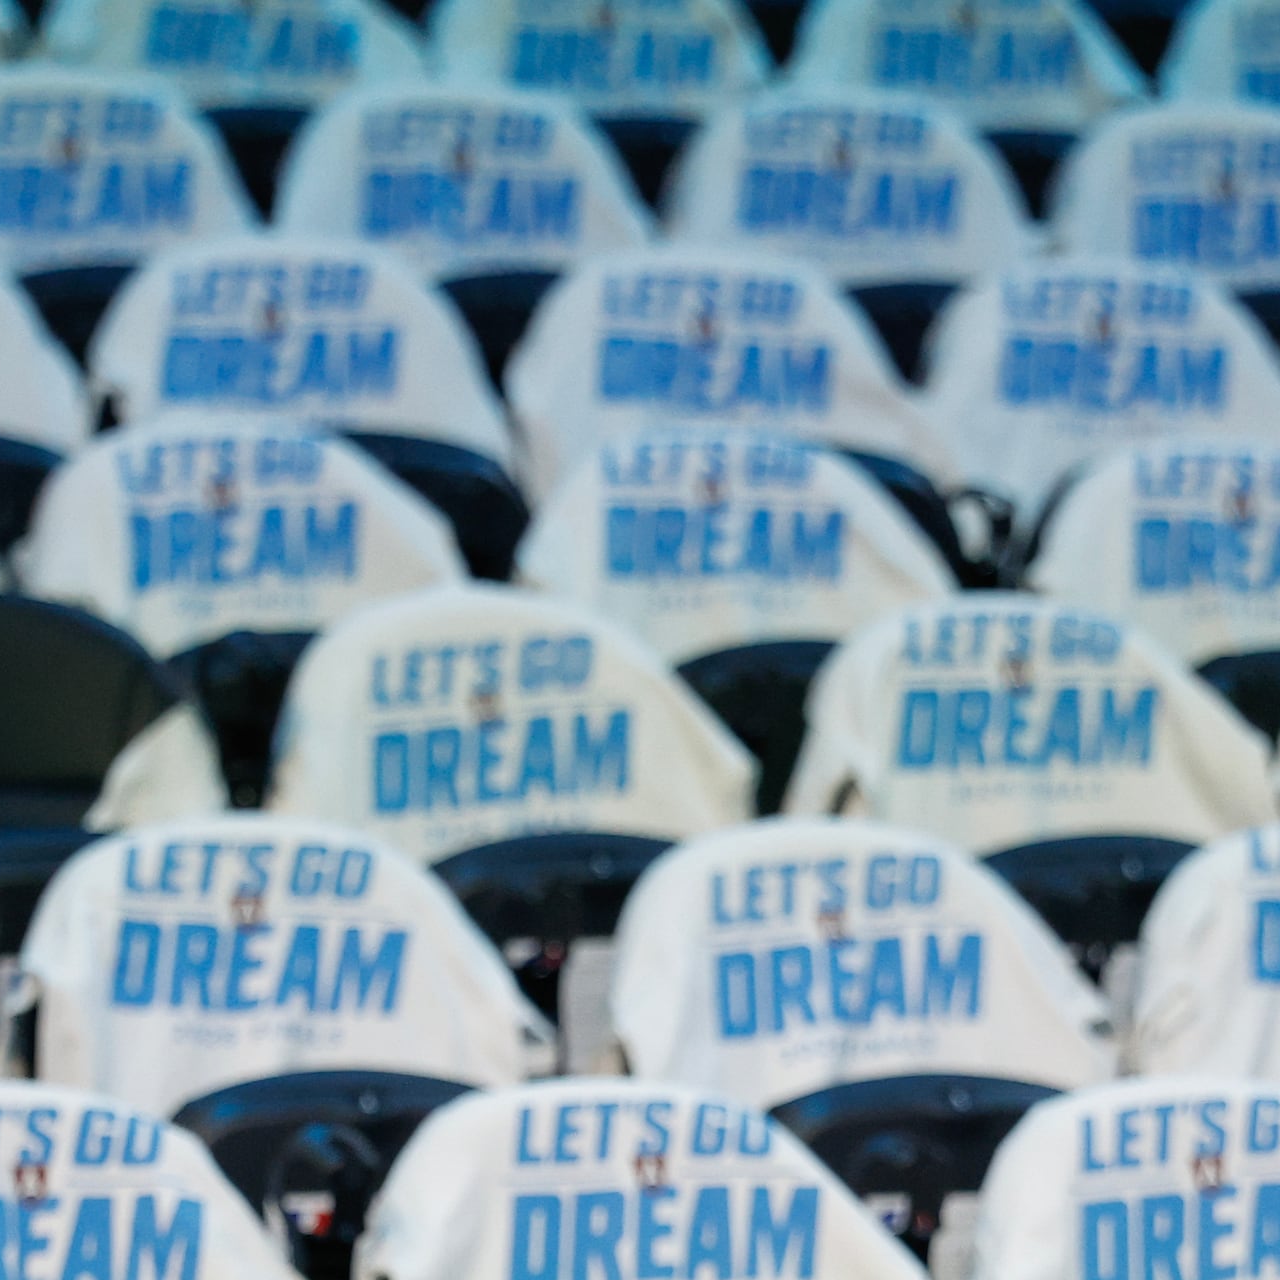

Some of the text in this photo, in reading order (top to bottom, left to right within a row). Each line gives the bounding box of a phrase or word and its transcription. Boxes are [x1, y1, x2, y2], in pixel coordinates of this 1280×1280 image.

[125, 844, 371, 896] LET'S GO
[715, 856, 940, 924] LET'S GO
[111, 919, 407, 1012] DREAM
[715, 934, 983, 1039] DREAM
[74, 1109, 163, 1166] GO
[517, 1102, 777, 1164] LET'S GO
[1084, 1101, 1226, 1172] LET'S
